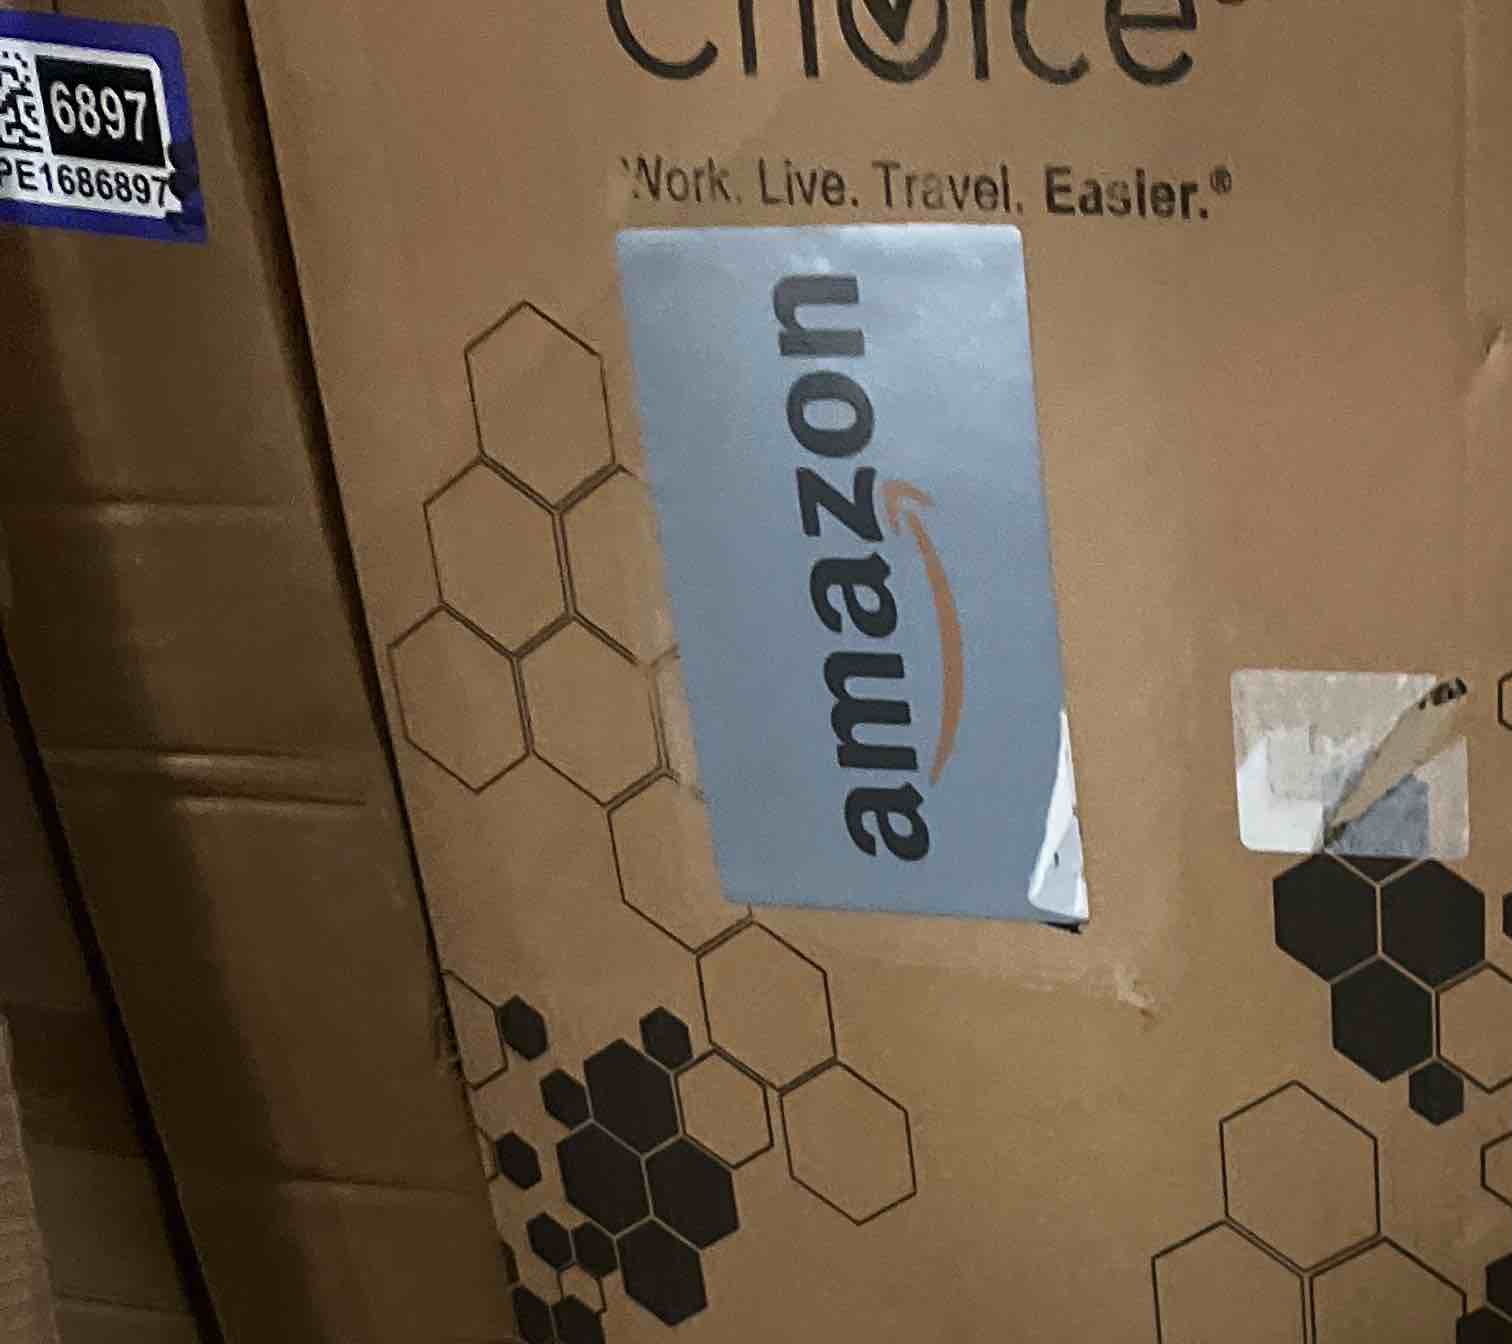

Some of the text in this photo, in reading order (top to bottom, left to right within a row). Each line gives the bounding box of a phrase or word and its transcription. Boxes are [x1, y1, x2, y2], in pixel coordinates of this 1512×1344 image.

[50, 80, 147, 142] 6897
[758, 158, 859, 208] Live.
[871, 160, 1024, 215] Travel.
[772, 271, 931, 863] amazon
